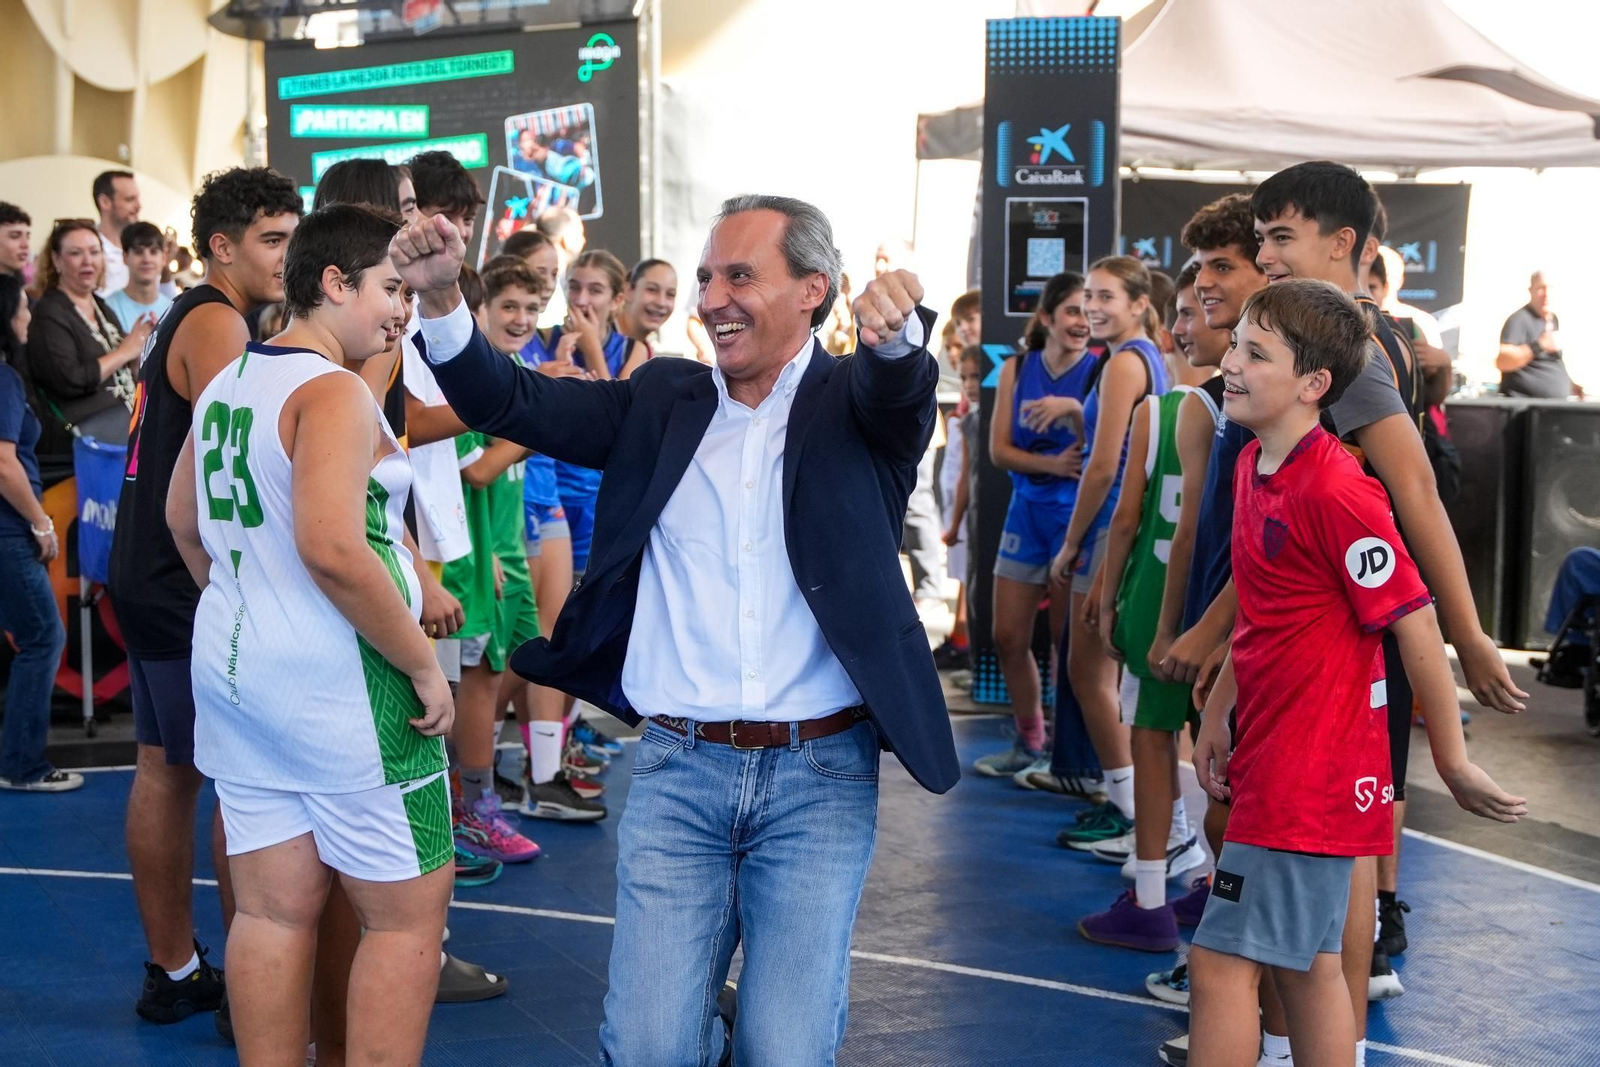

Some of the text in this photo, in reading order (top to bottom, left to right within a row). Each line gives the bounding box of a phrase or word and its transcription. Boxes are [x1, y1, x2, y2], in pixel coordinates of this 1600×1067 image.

[399, 111, 426, 132] EN
[1014, 168, 1086, 186] CaixaBank
[201, 400, 265, 529] 23
[1357, 545, 1389, 580] JD
[227, 622, 242, 677] Náutico
[227, 677, 242, 706] Club
